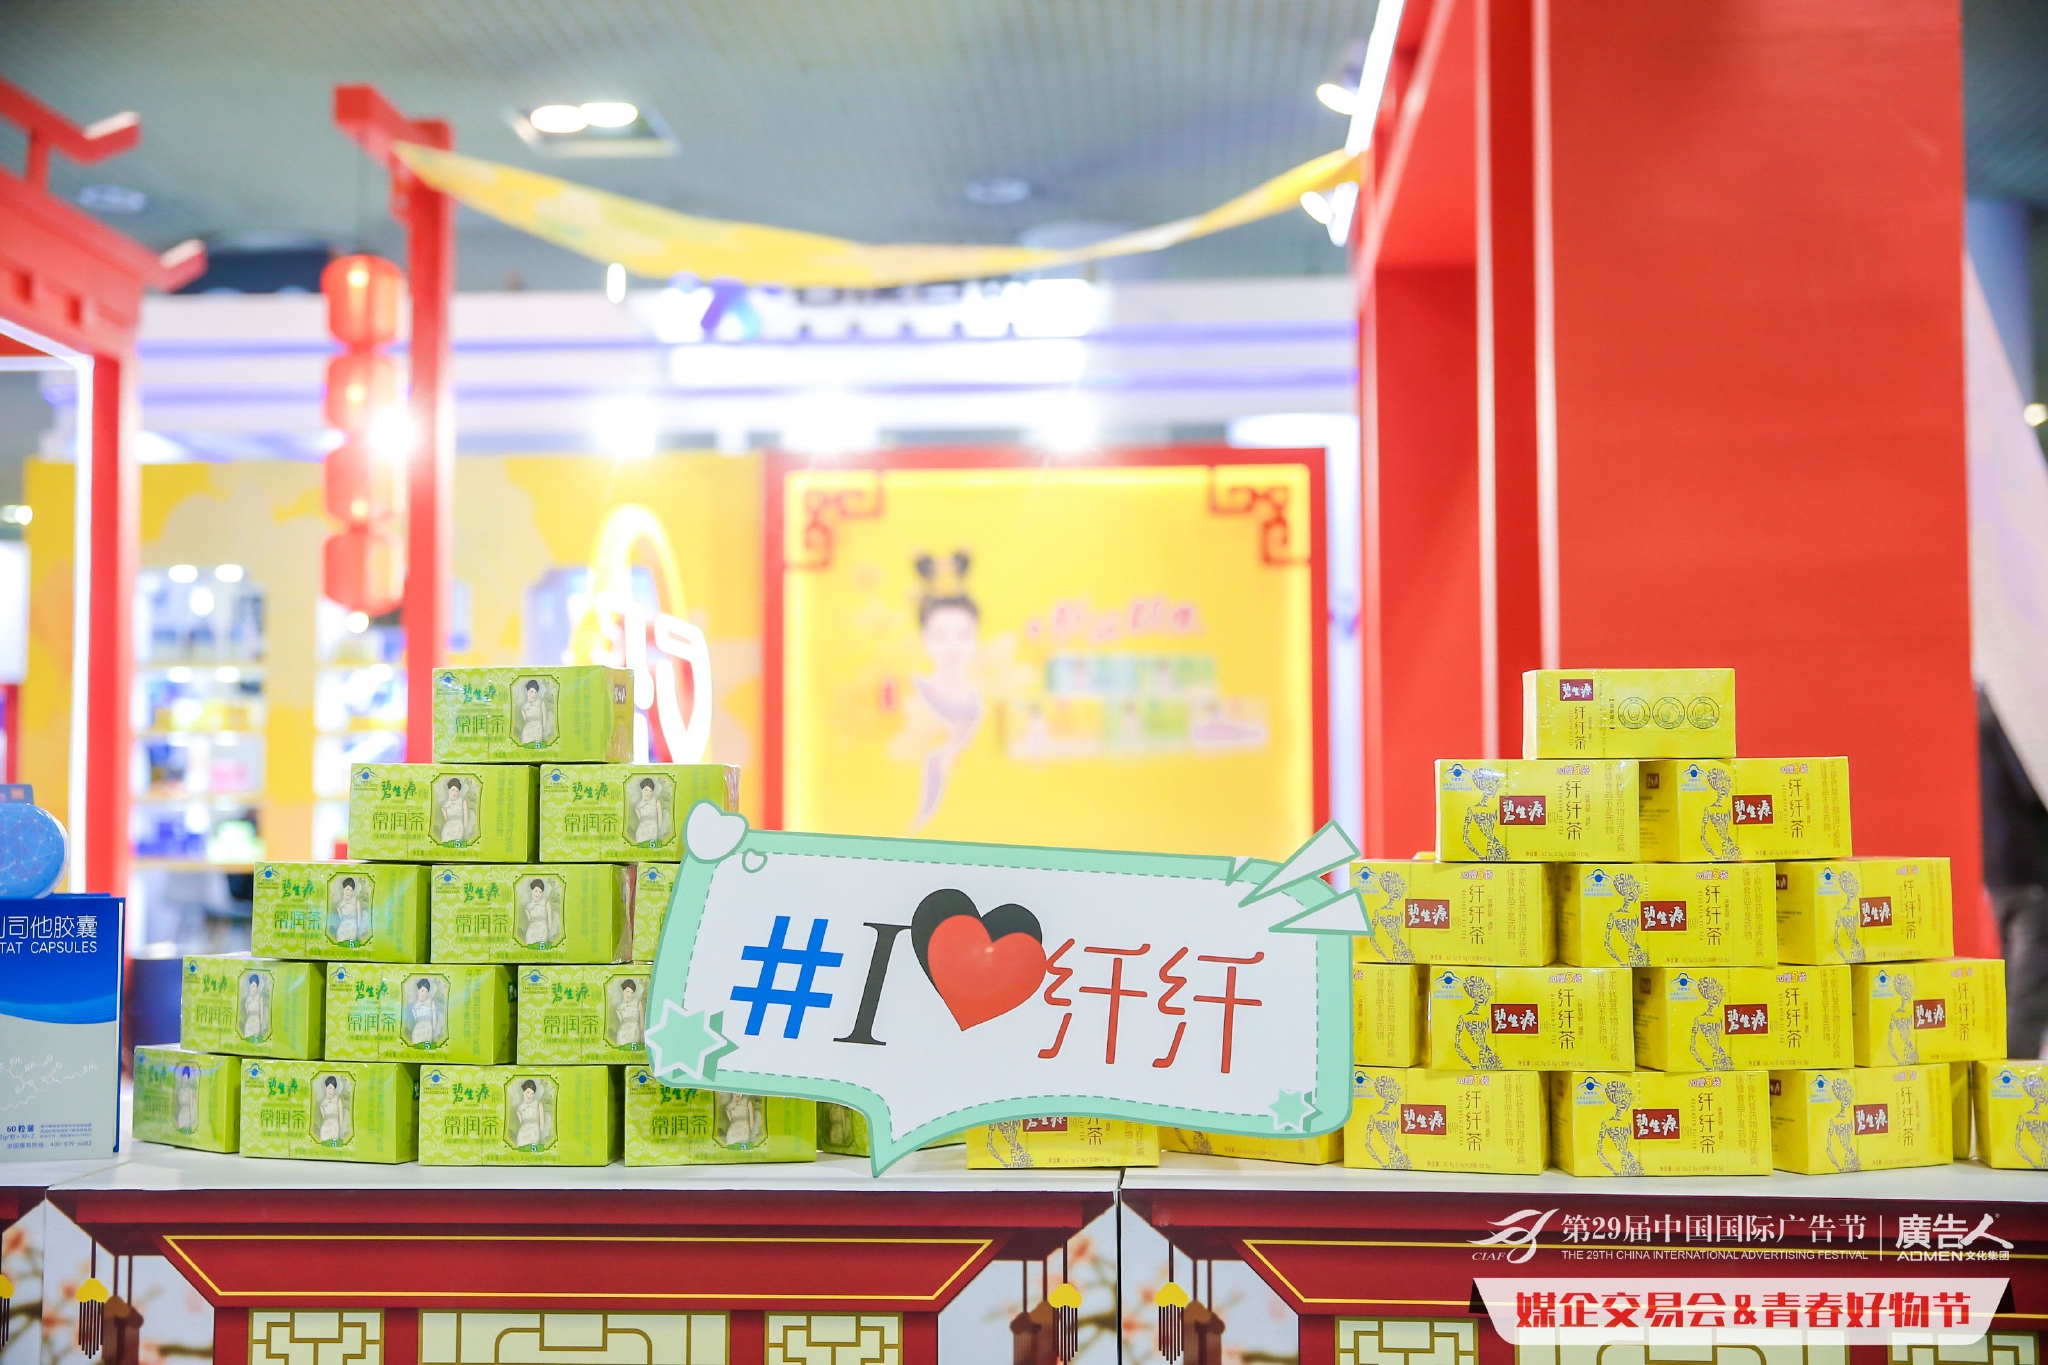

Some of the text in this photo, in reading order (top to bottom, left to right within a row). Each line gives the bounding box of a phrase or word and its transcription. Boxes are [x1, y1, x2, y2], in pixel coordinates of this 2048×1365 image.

[455, 715, 505, 734] 常润茶
[1574, 706, 1587, 750] 纤纤茶
[381, 779, 417, 800] 碧生源
[572, 782, 610, 802] 碧生源
[1502, 800, 1545, 823] 碧生源
[1566, 780, 1582, 840] 纤纤茶
[1735, 800, 1772, 823] 碧生源
[1789, 779, 1802, 838] 纤纤茶
[373, 812, 425, 831] 常润茶
[564, 813, 617, 833] 常润茶
[463, 882, 500, 903] 碧生源
[274, 910, 322, 929] 常润茶
[1408, 903, 1449, 926] 碧生源
[1469, 884, 1485, 944] 纤纤茶
[1643, 905, 1685, 929] 碧生源
[1705, 885, 1721, 945] 纤纤茶
[1861, 902, 1891, 925] 碧生源
[1904, 880, 1916, 939] 纤纤茶
[456, 914, 508, 934] 常润茶
[31, 941, 98, 954] CAPSULES
[355, 978, 389, 1001] 碧生源
[551, 982, 590, 1004] 碧生源
[1038, 938, 1264, 1074] 纤纤
[1786, 987, 1801, 1048] 纤纤茶
[1916, 1004, 1945, 1028] 碧生源
[1958, 982, 1969, 1041] 纤纤茶
[347, 1012, 397, 1032] 常润茶
[543, 1015, 599, 1034] 常润茶
[1494, 1009, 1538, 1032] 碧生源
[1558, 989, 1575, 1049] 纤纤茶
[1727, 1009, 1767, 1033] 碧生源
[452, 1083, 491, 1104] 碧生源
[260, 1110, 305, 1129] 常润茶
[444, 1116, 498, 1136] 常润茶
[652, 1116, 708, 1135] 常润茶
[1404, 1108, 1445, 1132] 碧生源
[1466, 1090, 1482, 1151] 纤纤茶
[1636, 1113, 1678, 1138] 碧生源
[1698, 1093, 1715, 1154] 纤纤茶
[1856, 1109, 1888, 1133] 碧生源
[1901, 1086, 1914, 1147] 纤纤茶
